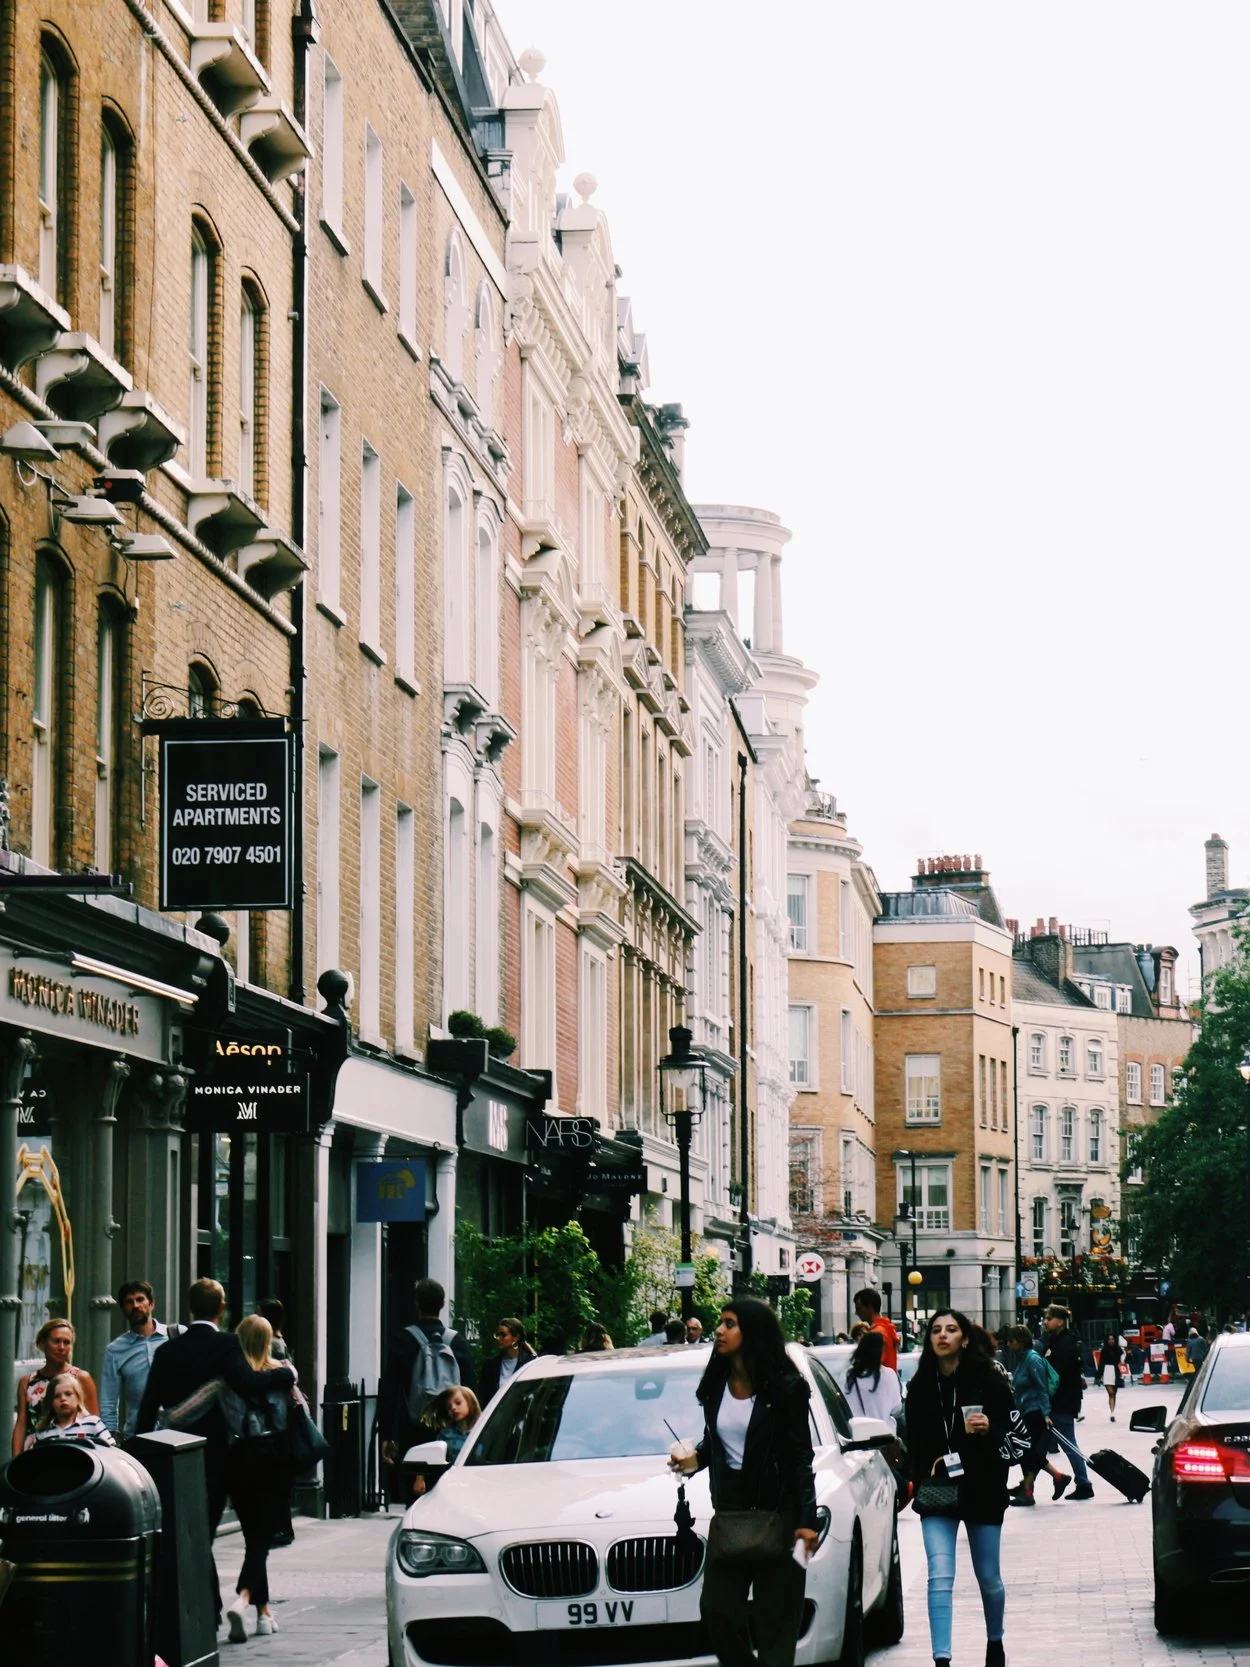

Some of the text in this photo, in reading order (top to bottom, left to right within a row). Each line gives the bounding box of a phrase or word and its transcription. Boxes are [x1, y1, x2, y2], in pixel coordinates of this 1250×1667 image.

[186, 783, 267, 801] SERVICED
[172, 806, 281, 827] APARTMENTS
[172, 845, 281, 865] 020 7907 4501
[9, 966, 140, 1037] MONICA VINADER
[194, 1085, 301, 1095] MONICA VINADER
[526, 1119, 592, 1147] NARS
[16, 1513, 68, 1524] general litter
[567, 1600, 634, 1625] 99 VV
